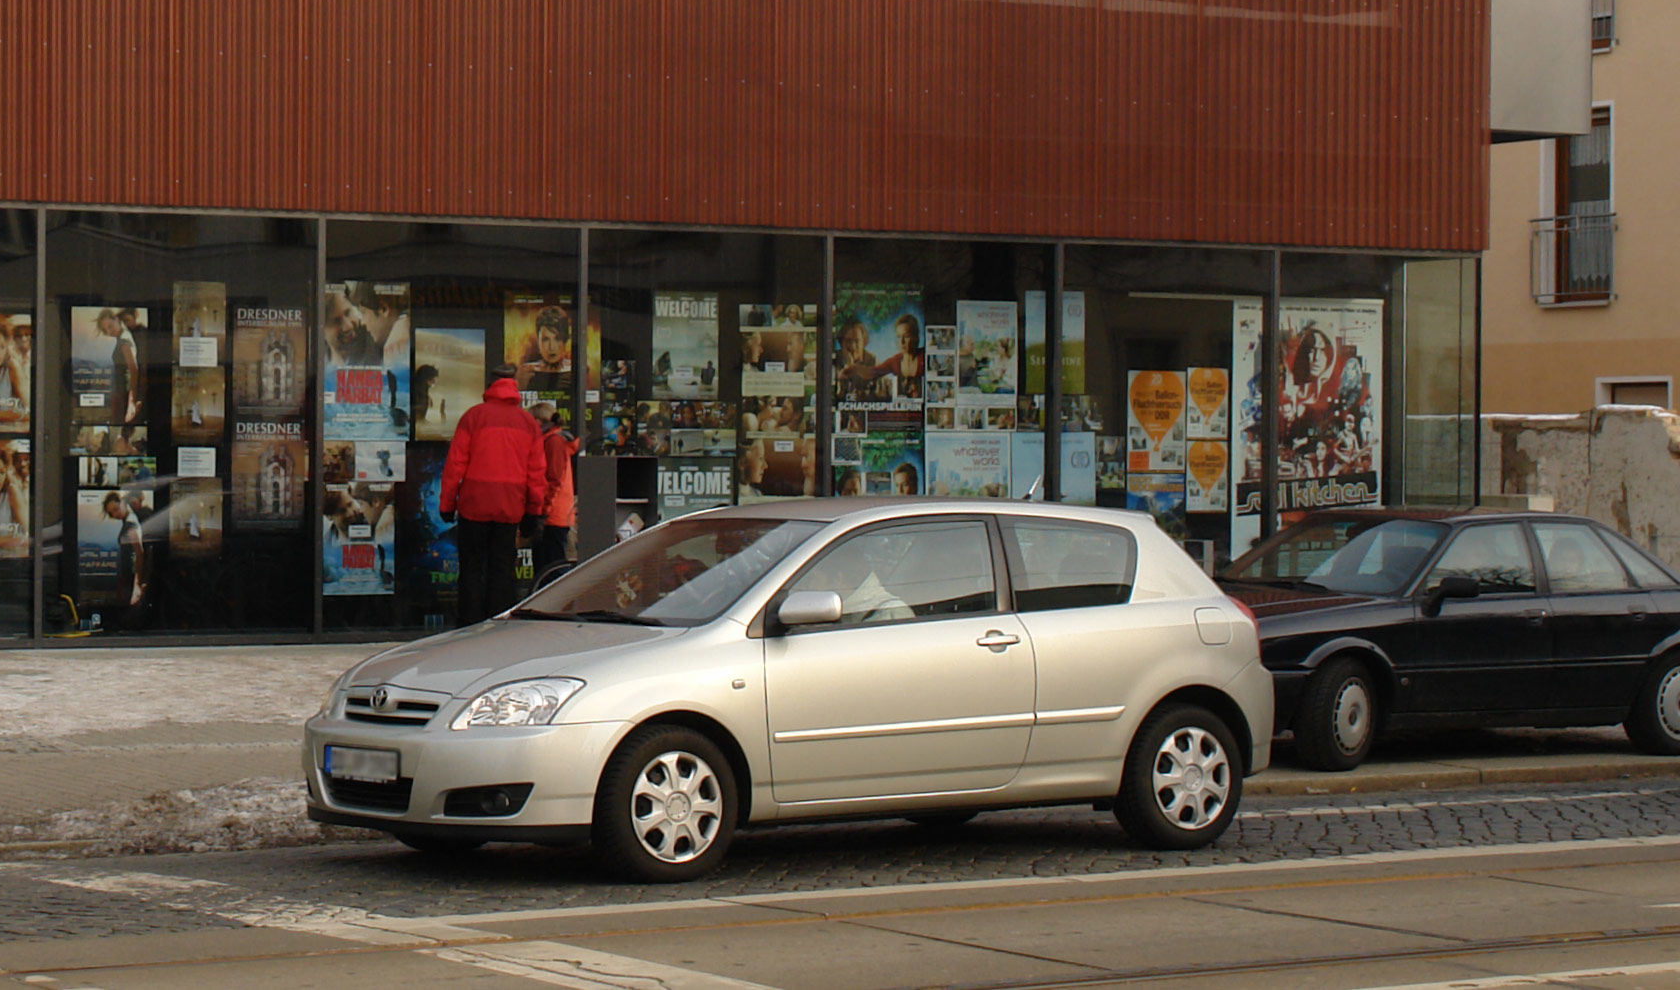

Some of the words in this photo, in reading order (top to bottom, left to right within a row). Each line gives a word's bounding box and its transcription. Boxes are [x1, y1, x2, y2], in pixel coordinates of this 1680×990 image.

[237, 308, 303, 321] DRESDNER
[655, 300, 718, 318] WELCOME
[336, 369, 382, 387] NANGA
[236, 422, 301, 434] DRESDNER
[1292, 478, 1378, 509] kitchen
